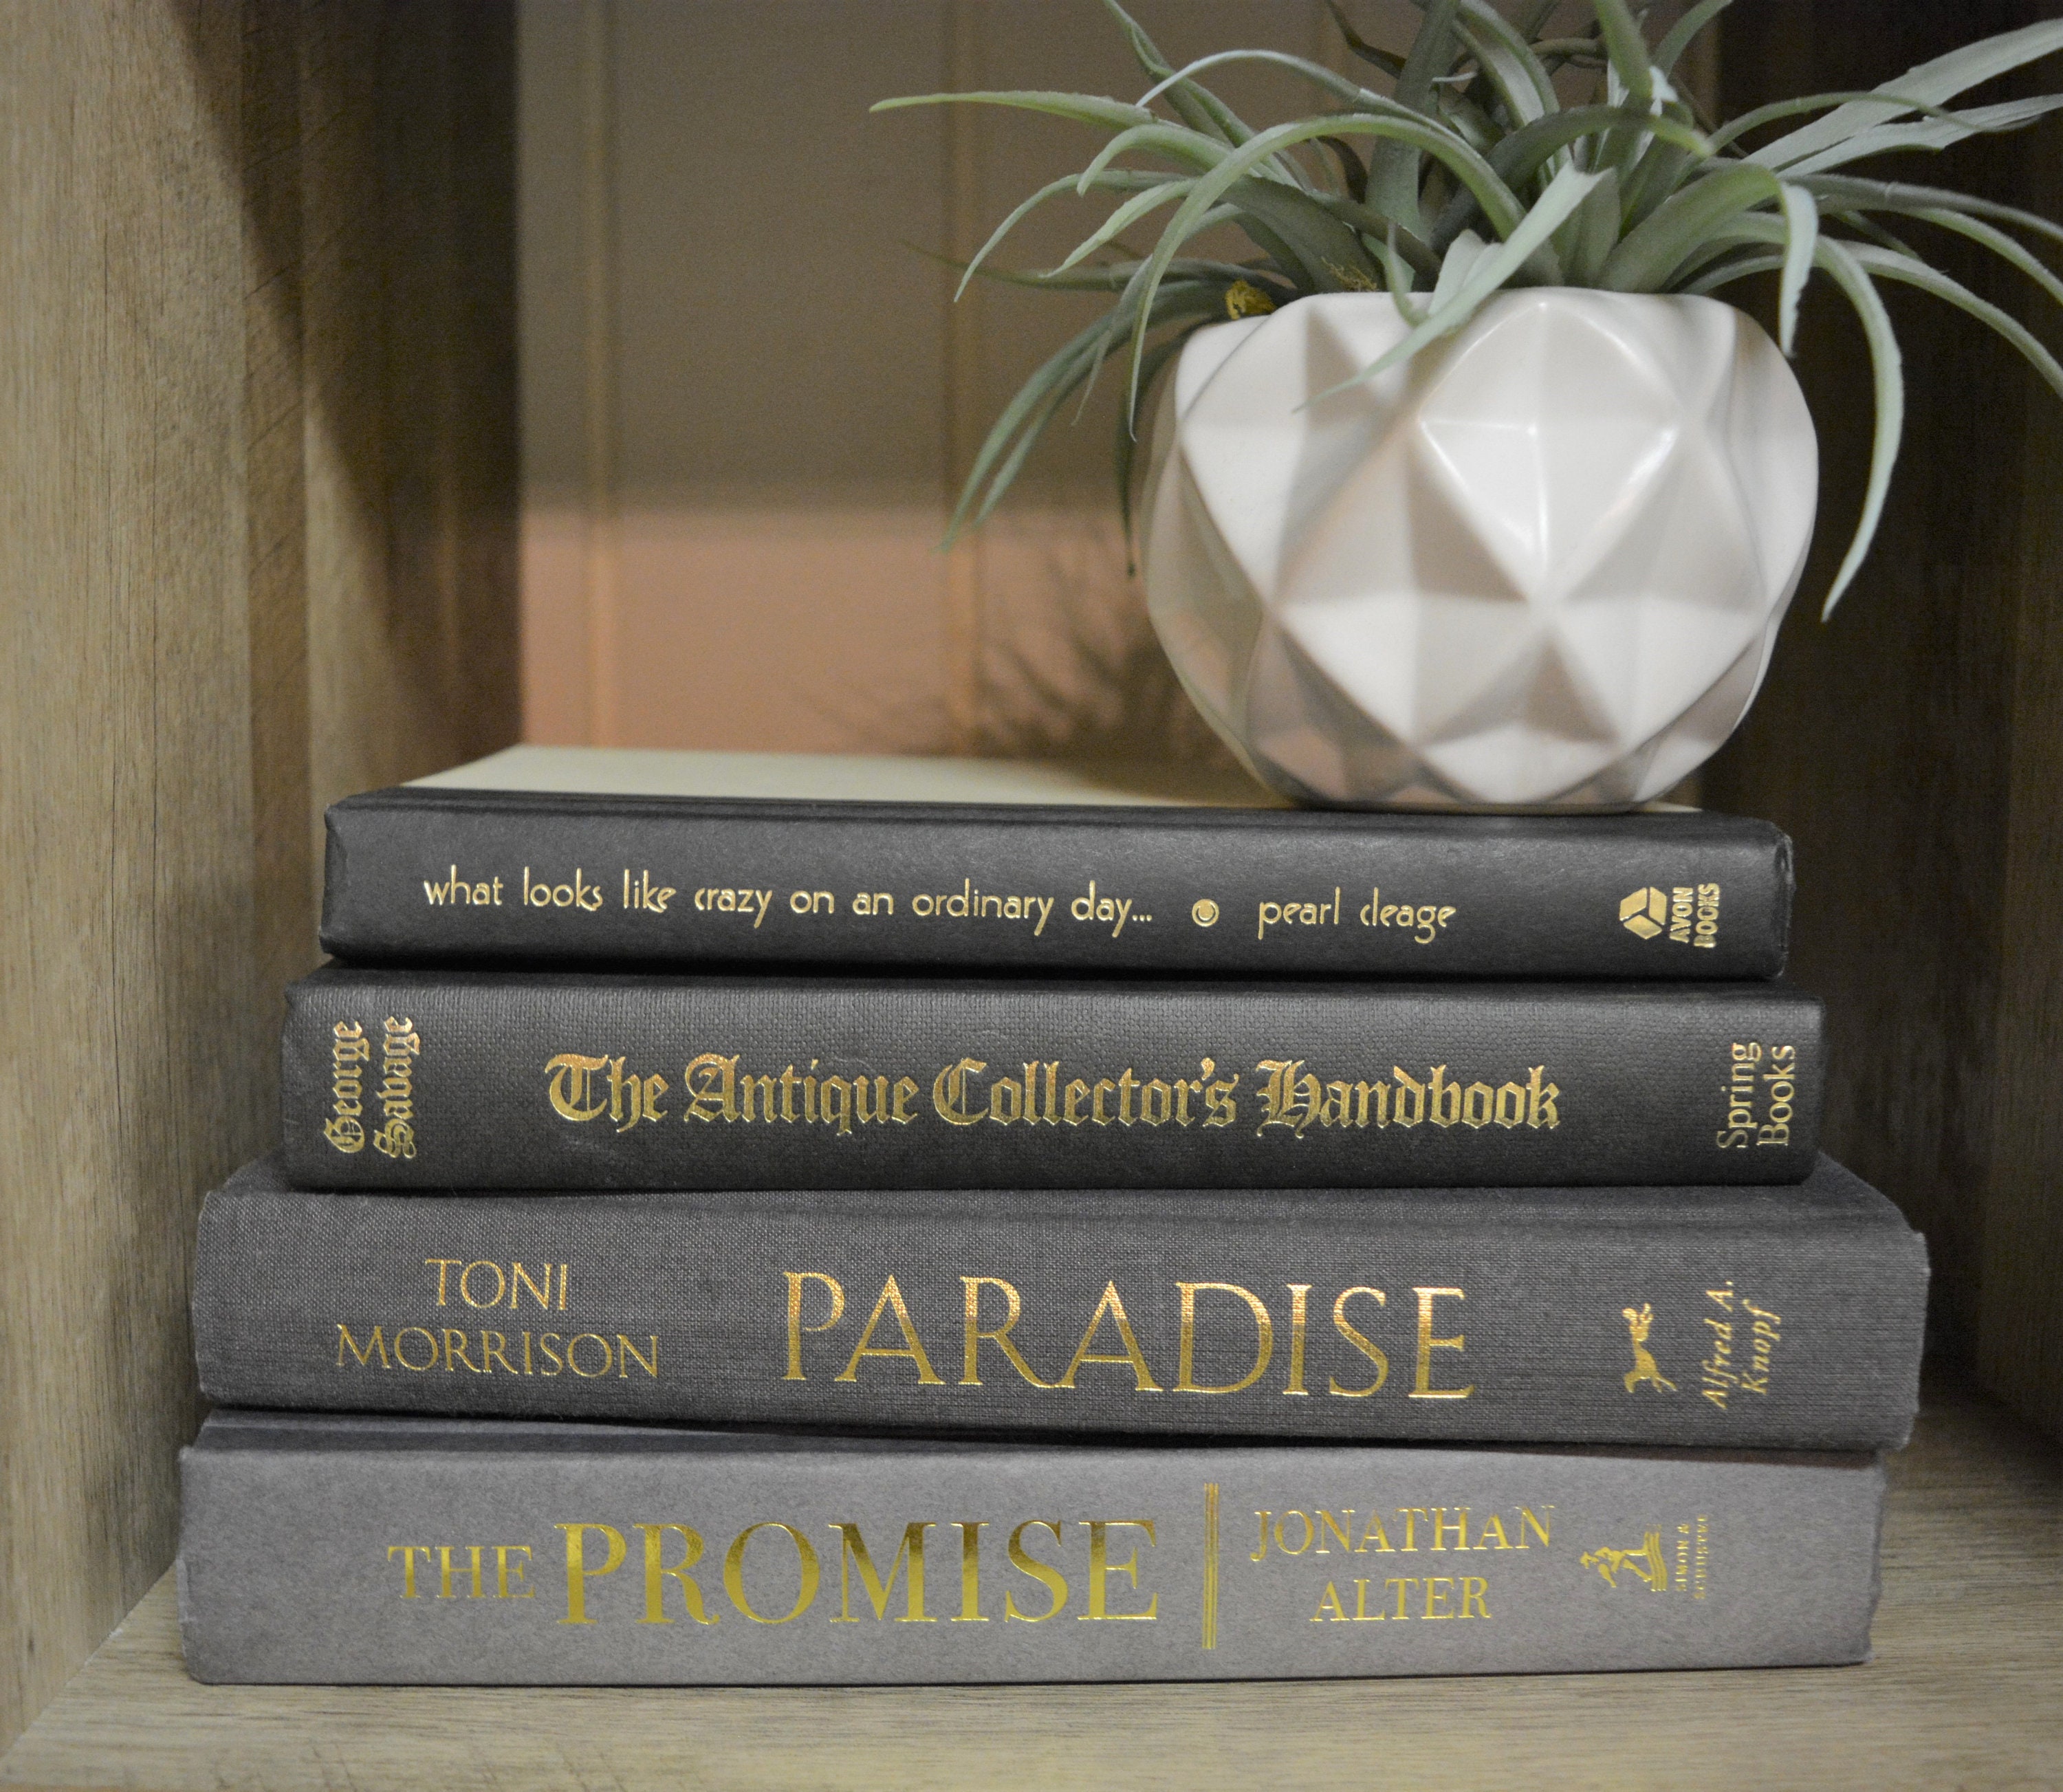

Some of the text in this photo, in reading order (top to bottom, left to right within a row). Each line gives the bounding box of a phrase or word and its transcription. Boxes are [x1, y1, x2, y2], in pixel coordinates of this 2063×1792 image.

[423, 864, 1153, 938] what looks like crazy on an ordinary day...
[1257, 886, 1458, 944] pearl cleage
[1669, 887, 1694, 943] AVON
[1693, 882, 1721, 948] BOOKS
[323, 1020, 371, 1154] George
[373, 1016, 421, 1159] Savage
[544, 1052, 1560, 1139] The Antique Collector's Handbook
[1716, 1042, 1762, 1148] Spring
[1756, 1045, 1797, 1146] Books
[425, 1258, 568, 1311] TONI
[336, 1322, 659, 1379] MORRISON
[782, 1271, 1476, 1399] PARADISE
[1701, 1318, 1739, 1410] Alfred
[1740, 1298, 1782, 1395] Knopf
[386, 1518, 1159, 1626] THE PROMISE
[1249, 1504, 1556, 1562] JONATHAN
[1309, 1575, 1493, 1622] ALTER
